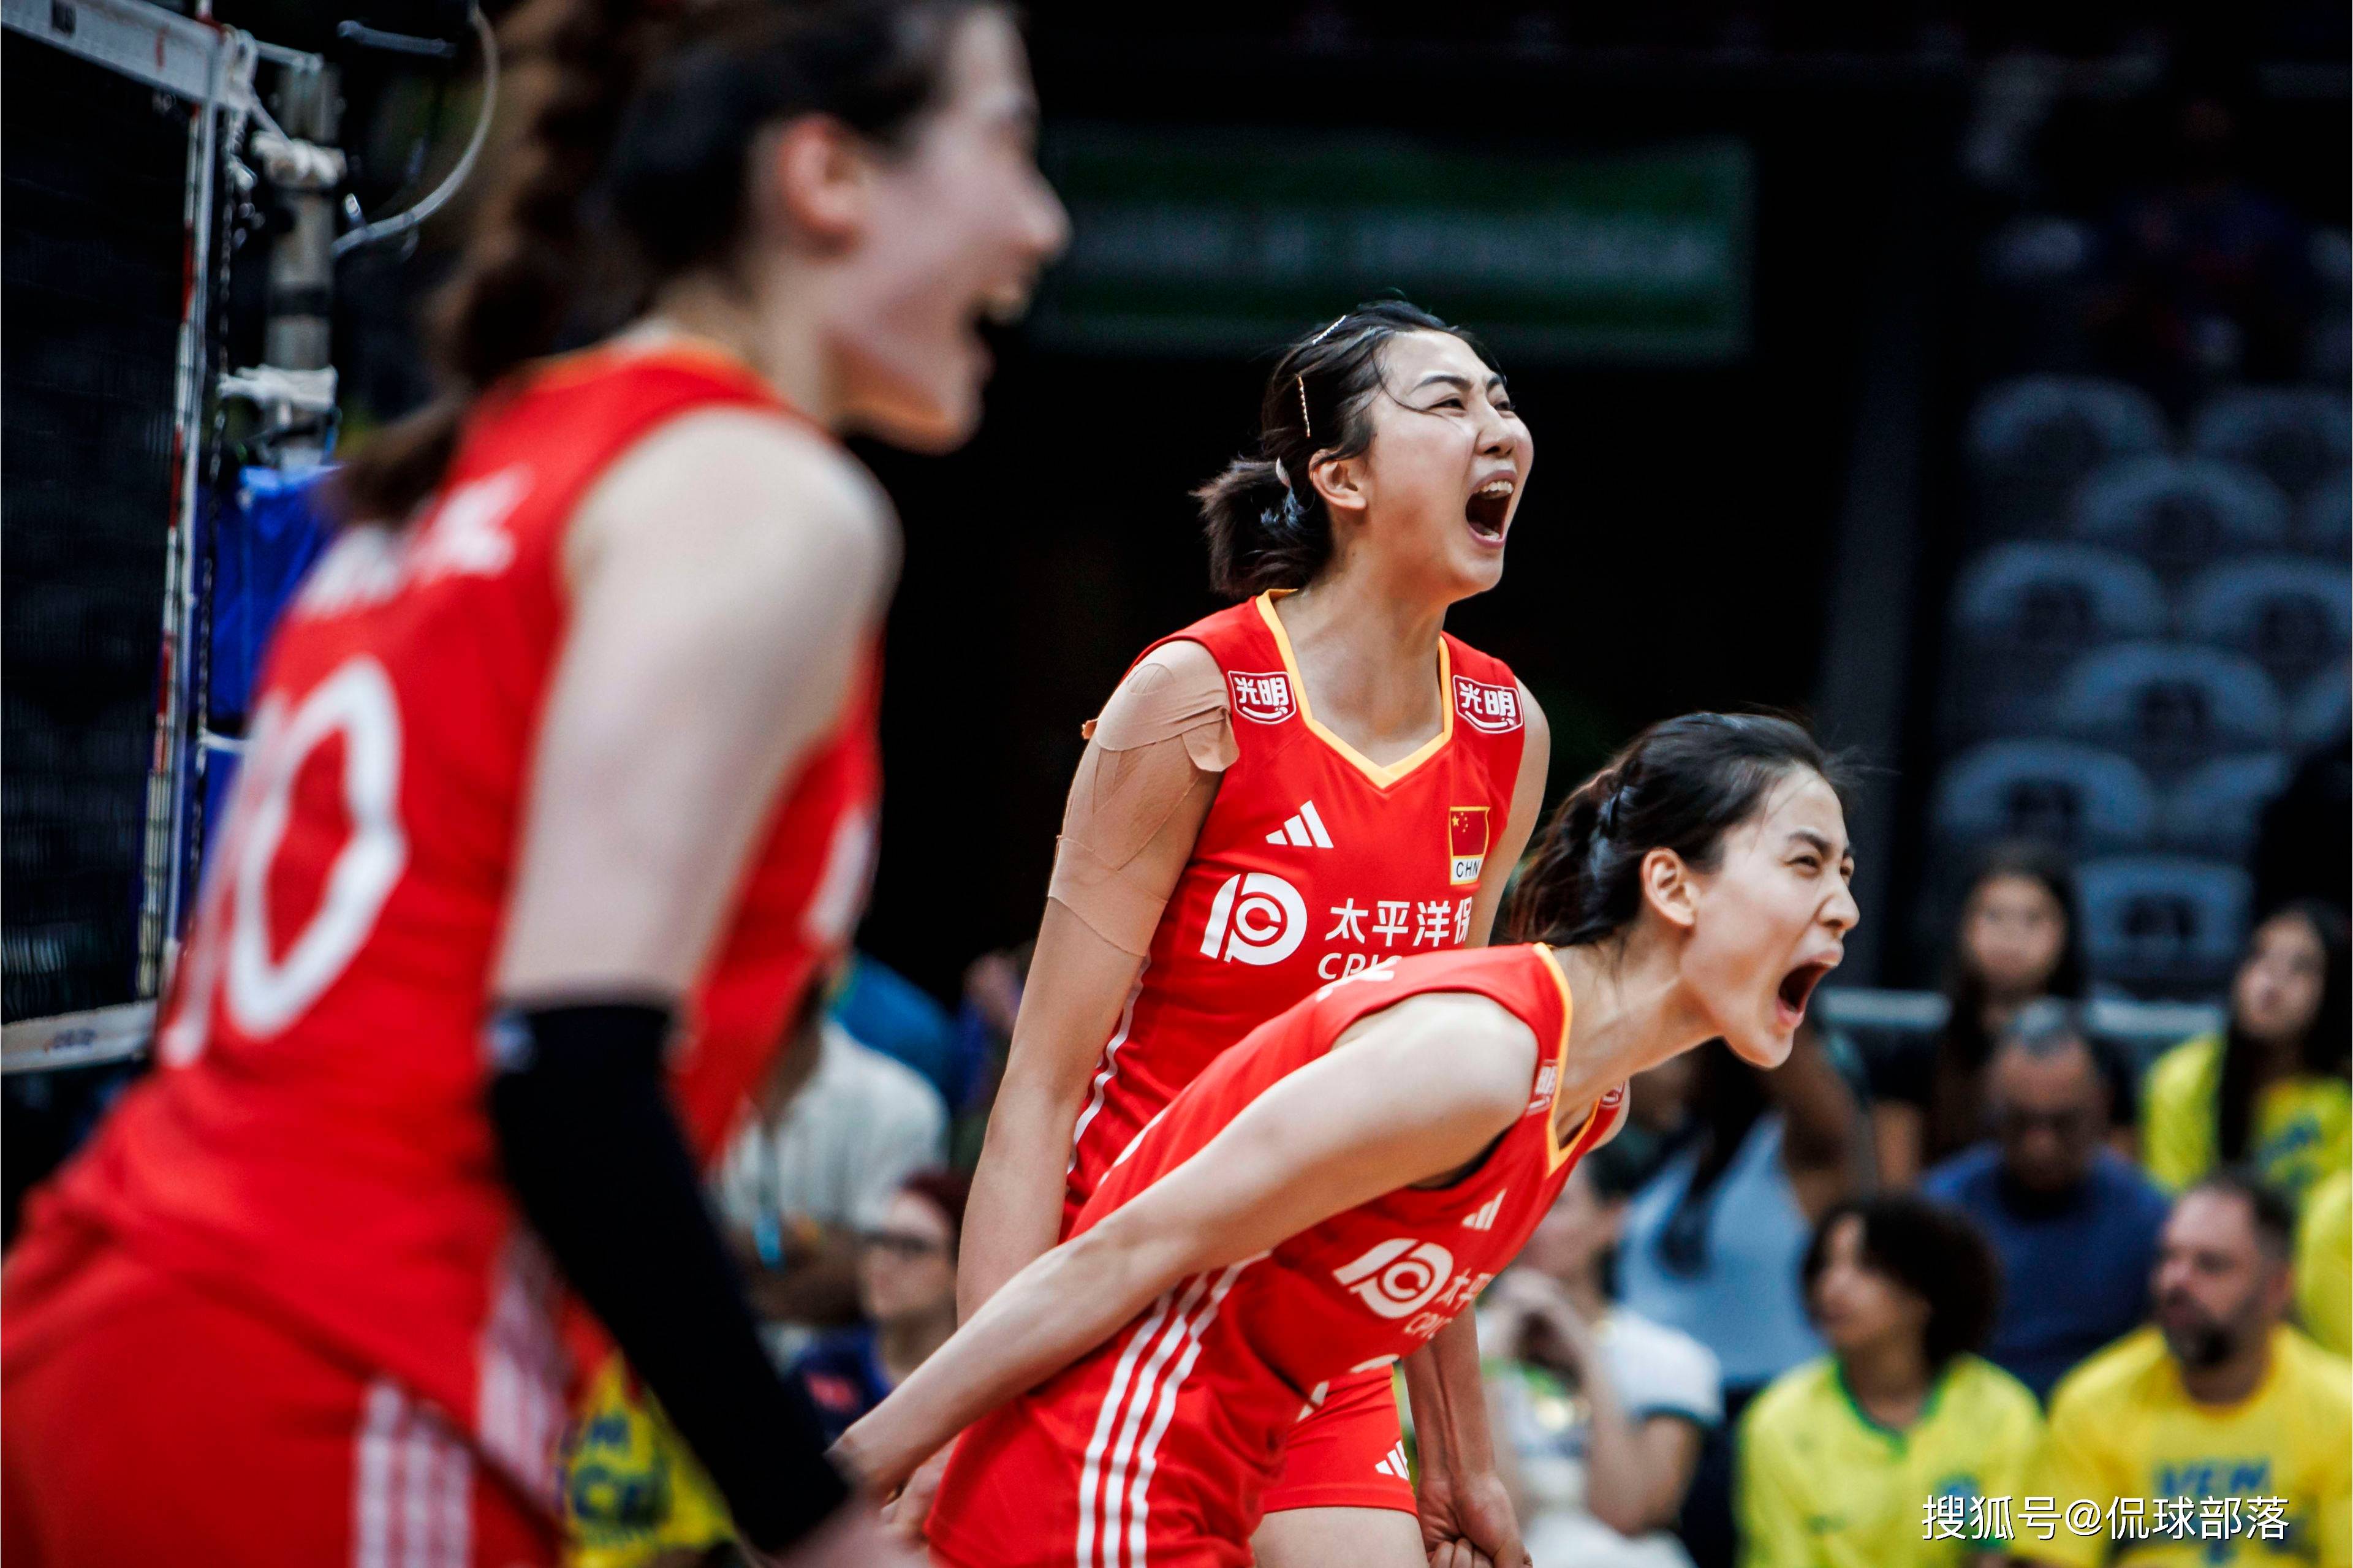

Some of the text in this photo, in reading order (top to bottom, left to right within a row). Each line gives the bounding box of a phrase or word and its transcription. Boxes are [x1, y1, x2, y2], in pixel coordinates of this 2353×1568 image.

[1234, 677, 1289, 706] 光明
[1459, 682, 1515, 717] 光明
[1456, 860, 1480, 878] CHN
